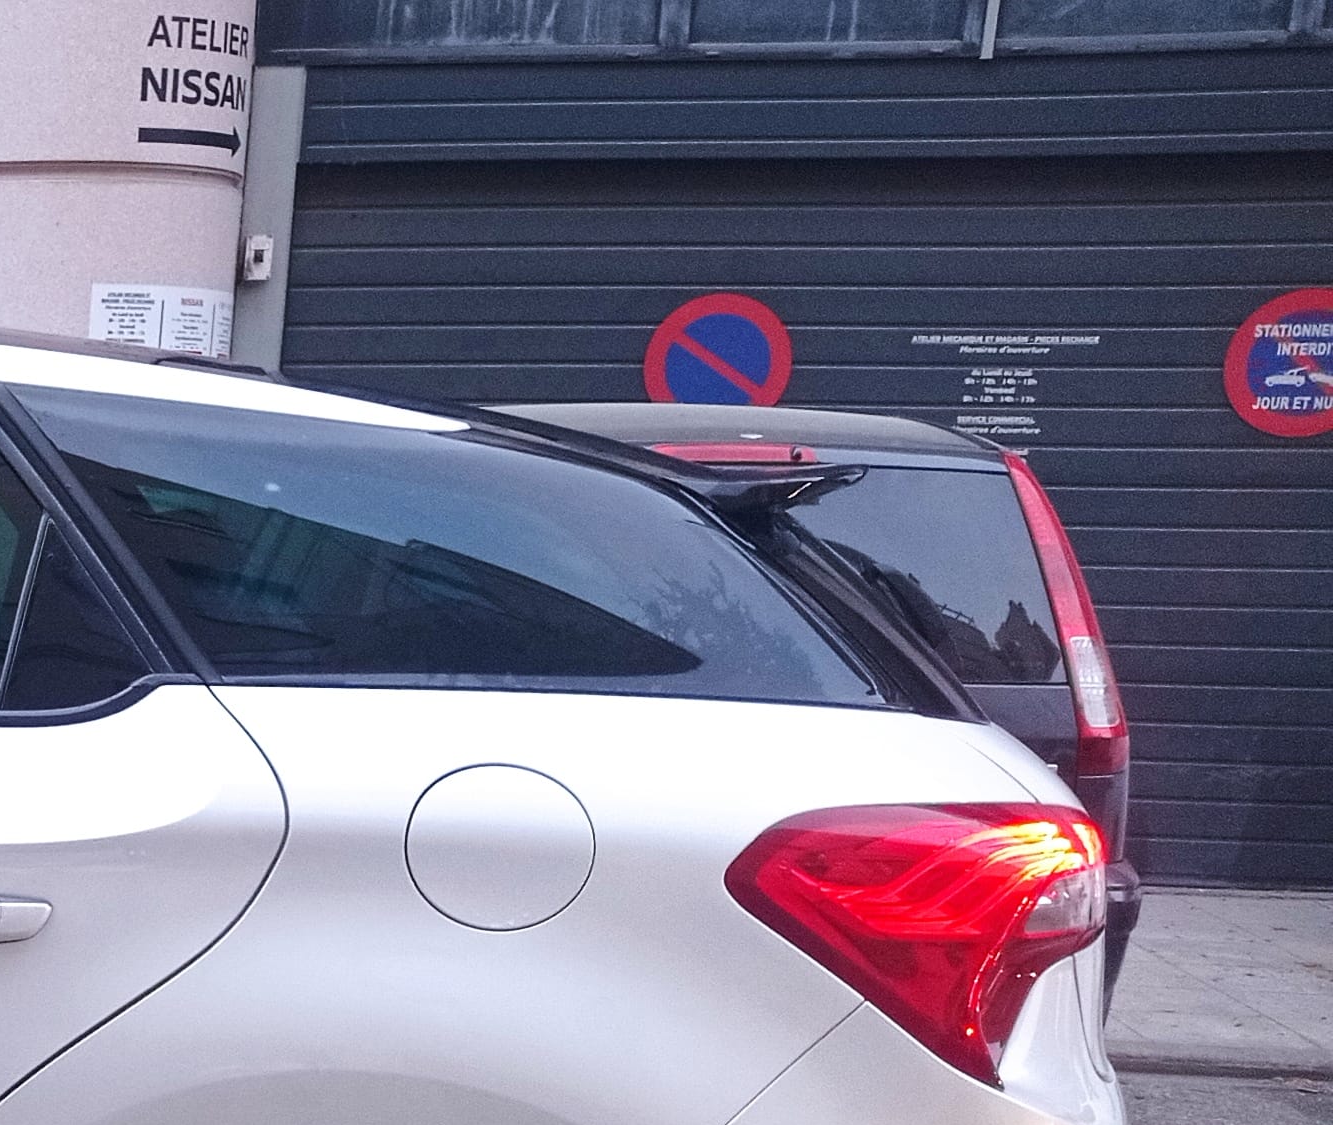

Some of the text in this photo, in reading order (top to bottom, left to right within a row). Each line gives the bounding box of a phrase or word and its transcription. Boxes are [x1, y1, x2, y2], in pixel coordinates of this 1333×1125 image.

[147, 15, 249, 58] ATELIER
[140, 67, 247, 112] NISSAN
[1254, 324, 1333, 338] STATIONNE
[1252, 396, 1289, 410] JOUR
[1292, 396, 1311, 410] ET
